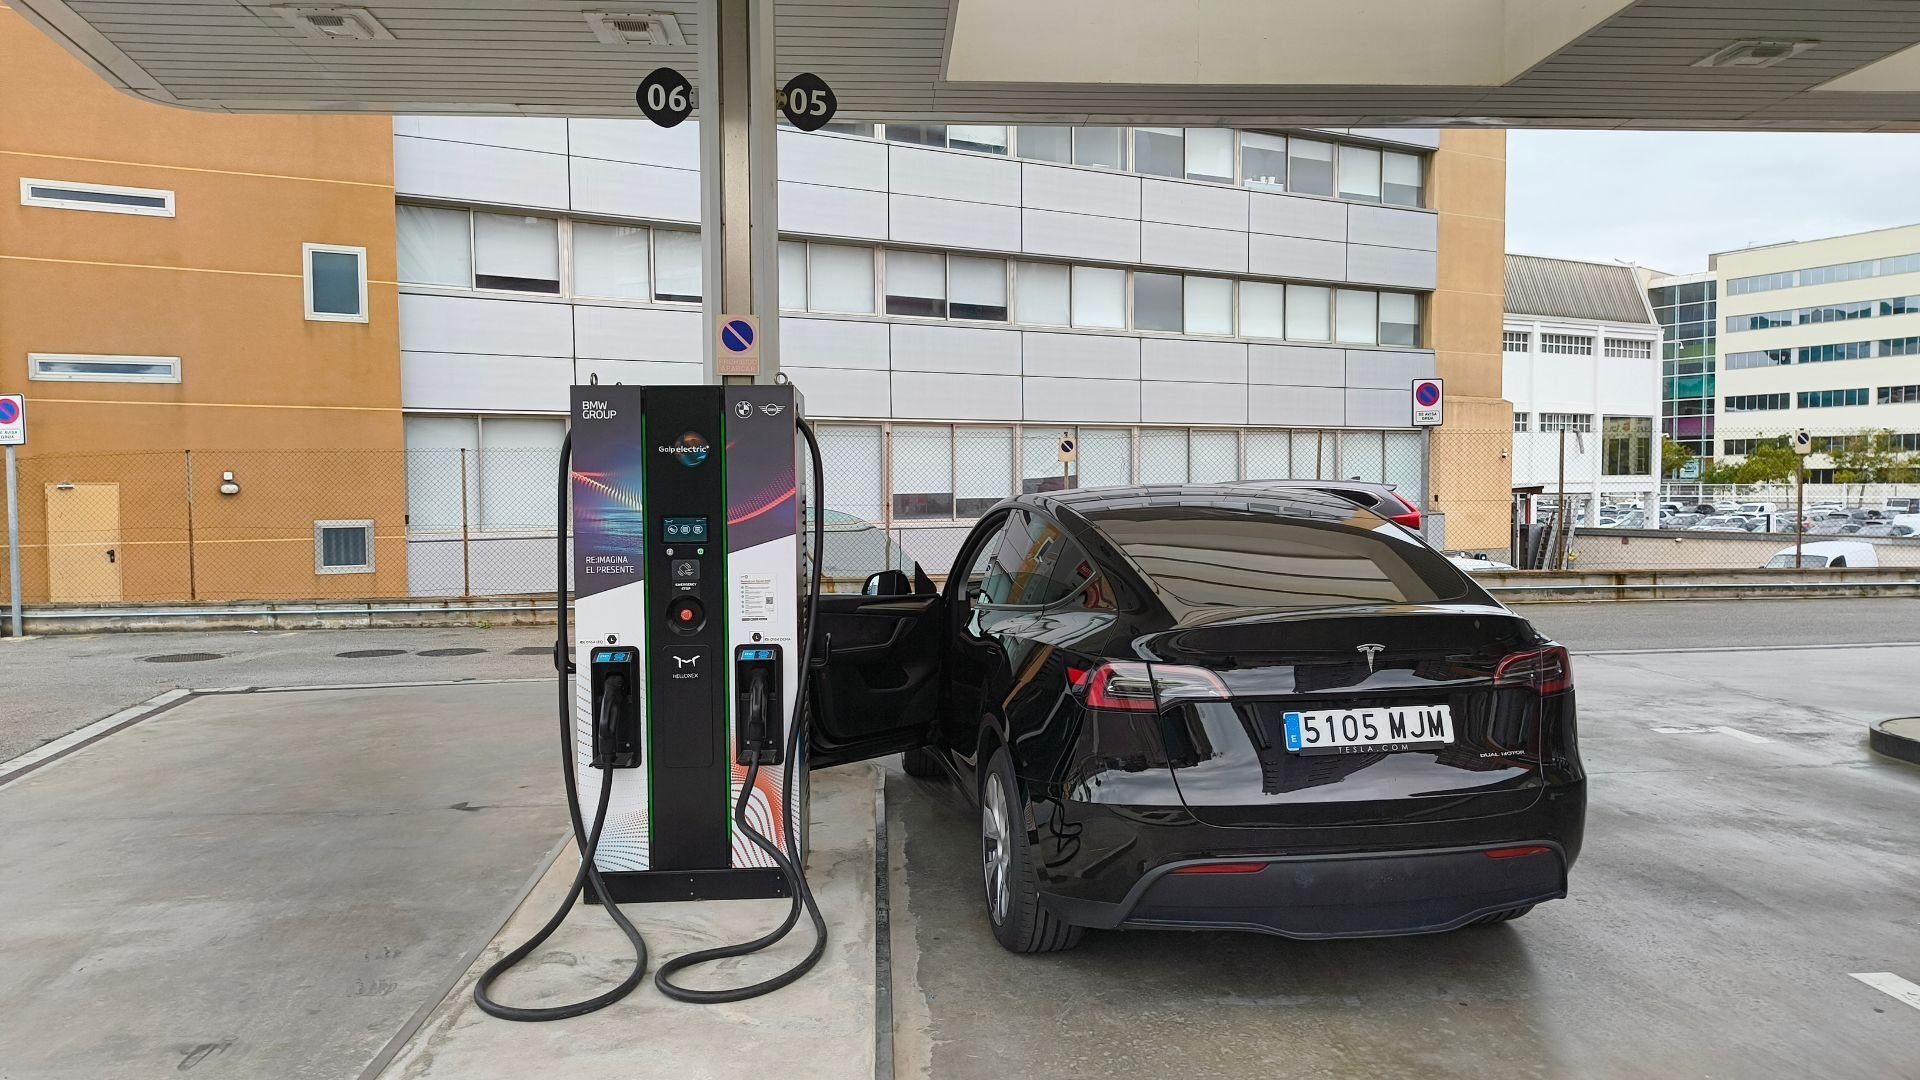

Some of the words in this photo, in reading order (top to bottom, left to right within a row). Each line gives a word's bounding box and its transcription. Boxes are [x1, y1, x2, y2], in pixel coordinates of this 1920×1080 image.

[647, 83, 687, 112] 06
[789, 87, 827, 116] 05
[582, 400, 608, 410] BMW
[582, 410, 617, 420] GROUP
[585, 555, 628, 564] RE:IMAGINA
[585, 566, 596, 574] EL
[596, 565, 635, 574] PRESENTE
[1303, 713, 1379, 744] 5105
[1388, 710, 1445, 740] MJM
[1290, 734, 1298, 743] E
[1338, 743, 1410, 755] TESLA.COM
